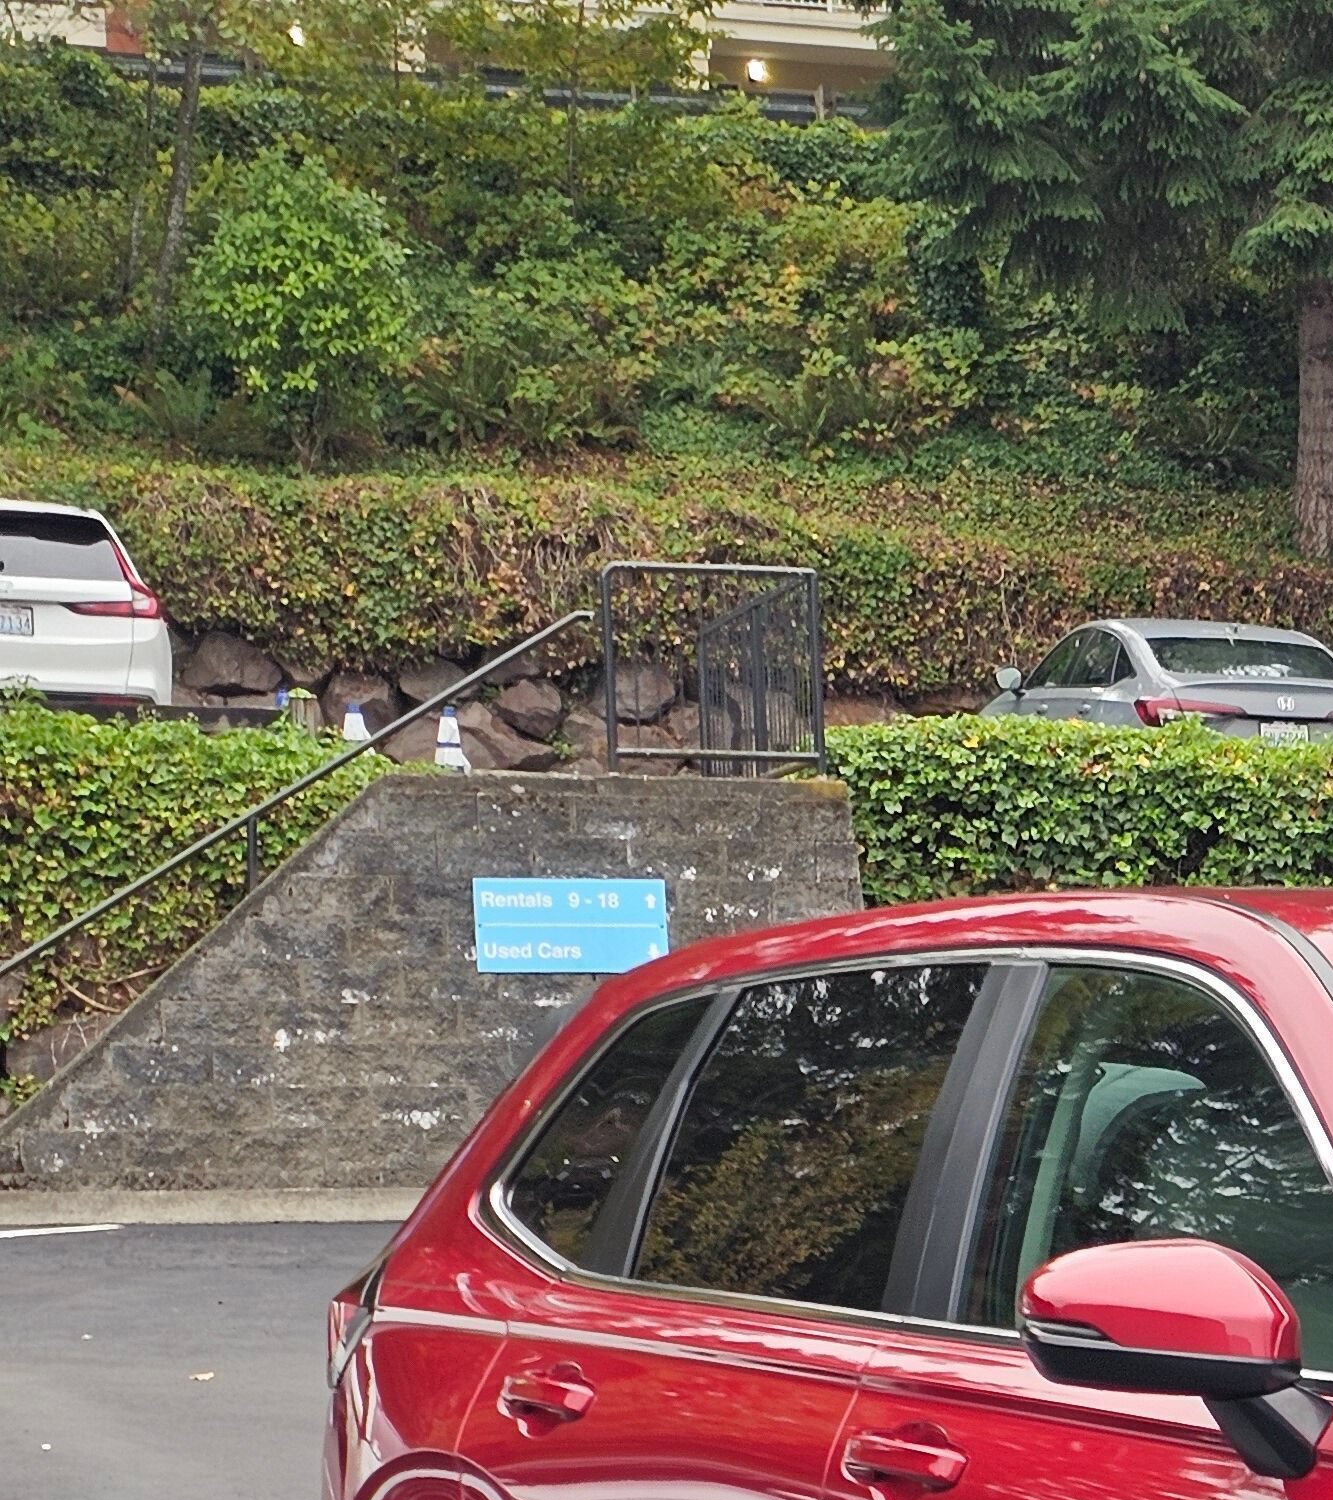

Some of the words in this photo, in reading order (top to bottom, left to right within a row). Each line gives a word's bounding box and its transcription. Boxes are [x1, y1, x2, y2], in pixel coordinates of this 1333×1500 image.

[480, 891, 553, 908] Rentals
[568, 892, 580, 908] 9
[598, 892, 619, 908] 18
[484, 942, 532, 959] Used
[538, 942, 582, 960] Cars
